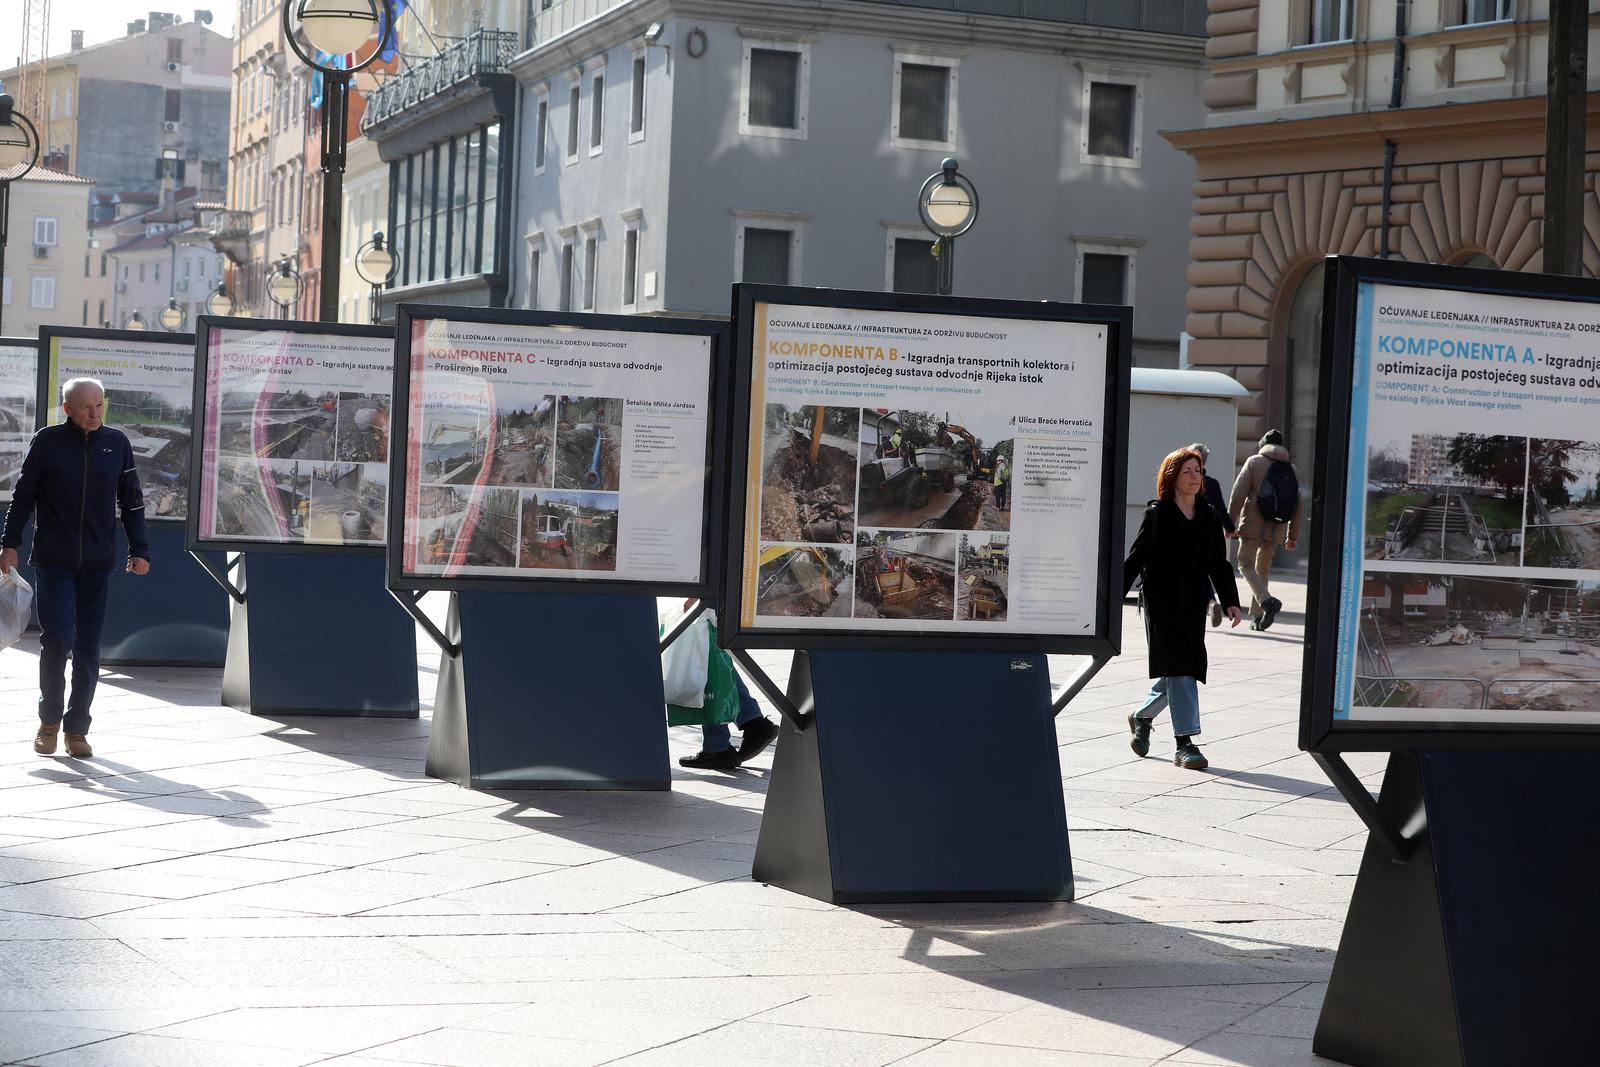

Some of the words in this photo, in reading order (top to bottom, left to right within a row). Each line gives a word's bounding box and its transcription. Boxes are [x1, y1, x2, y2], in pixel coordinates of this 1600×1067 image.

[1380, 306, 1428, 318] OČUVANJE
[1431, 311, 1479, 322] LEDENJAKA
[1491, 317, 1562, 330] INFRASTRUKTURA
[769, 319, 811, 328] OČUVANJE
[812, 322, 851, 331] LEDENJAKA
[862, 326, 921, 335] INFRASTRUKTURA
[934, 329, 964, 337] ODRŽIVU
[1456, 324, 1500, 333] INFRASTRUCTURE
[504, 336, 554, 345] INFRASTRUKTURA
[769, 341, 884, 360] KOMPONENTA
[889, 348, 898, 361] B
[908, 353, 955, 365] Izgradnja
[958, 356, 1020, 368] transportnih
[1023, 359, 1069, 371] kolektora
[1072, 362, 1075, 371] i
[1378, 335, 1517, 363] KOMPONENTA
[1522, 348, 1535, 364] A
[144, 364, 172, 372] Izgradnja
[224, 353, 303, 366] KOMPONENTA
[306, 358, 314, 366] D
[322, 361, 356, 370] Izgradnja
[428, 348, 523, 363] KOMPONENTA
[527, 354, 536, 364] C
[547, 358, 587, 368] Izgradnja
[623, 362, 662, 371] odvodnje
[269, 366, 292, 374] Kastav
[435, 363, 479, 373] Proširenje
[482, 365, 507, 375] Rijeka
[768, 360, 833, 372] optimizacija
[837, 364, 892, 377] postojećeg
[895, 368, 933, 377] sustava
[936, 369, 983, 381] odvodnje
[986, 371, 1016, 383] Rijeka
[1019, 373, 1043, 383] istok
[1377, 361, 1457, 379] optimizacija
[1461, 367, 1527, 385] postojećeg
[1530, 374, 1575, 387] sustava
[821, 380, 861, 388] Construction
[870, 383, 898, 391] transport
[935, 386, 973, 394] optimisation
[1376, 381, 1430, 392] COMPONENT
[1442, 386, 1491, 397] Construction
[1502, 390, 1534, 401] transport
[1536, 395, 1562, 403] sewage
[1389, 395, 1418, 405] existing
[1420, 396, 1445, 406] Rijeka
[1447, 398, 1466, 407] West
[1468, 401, 1495, 410] sewage
[1497, 402, 1521, 411] system
[1059, 418, 1092, 426] Horvatića
